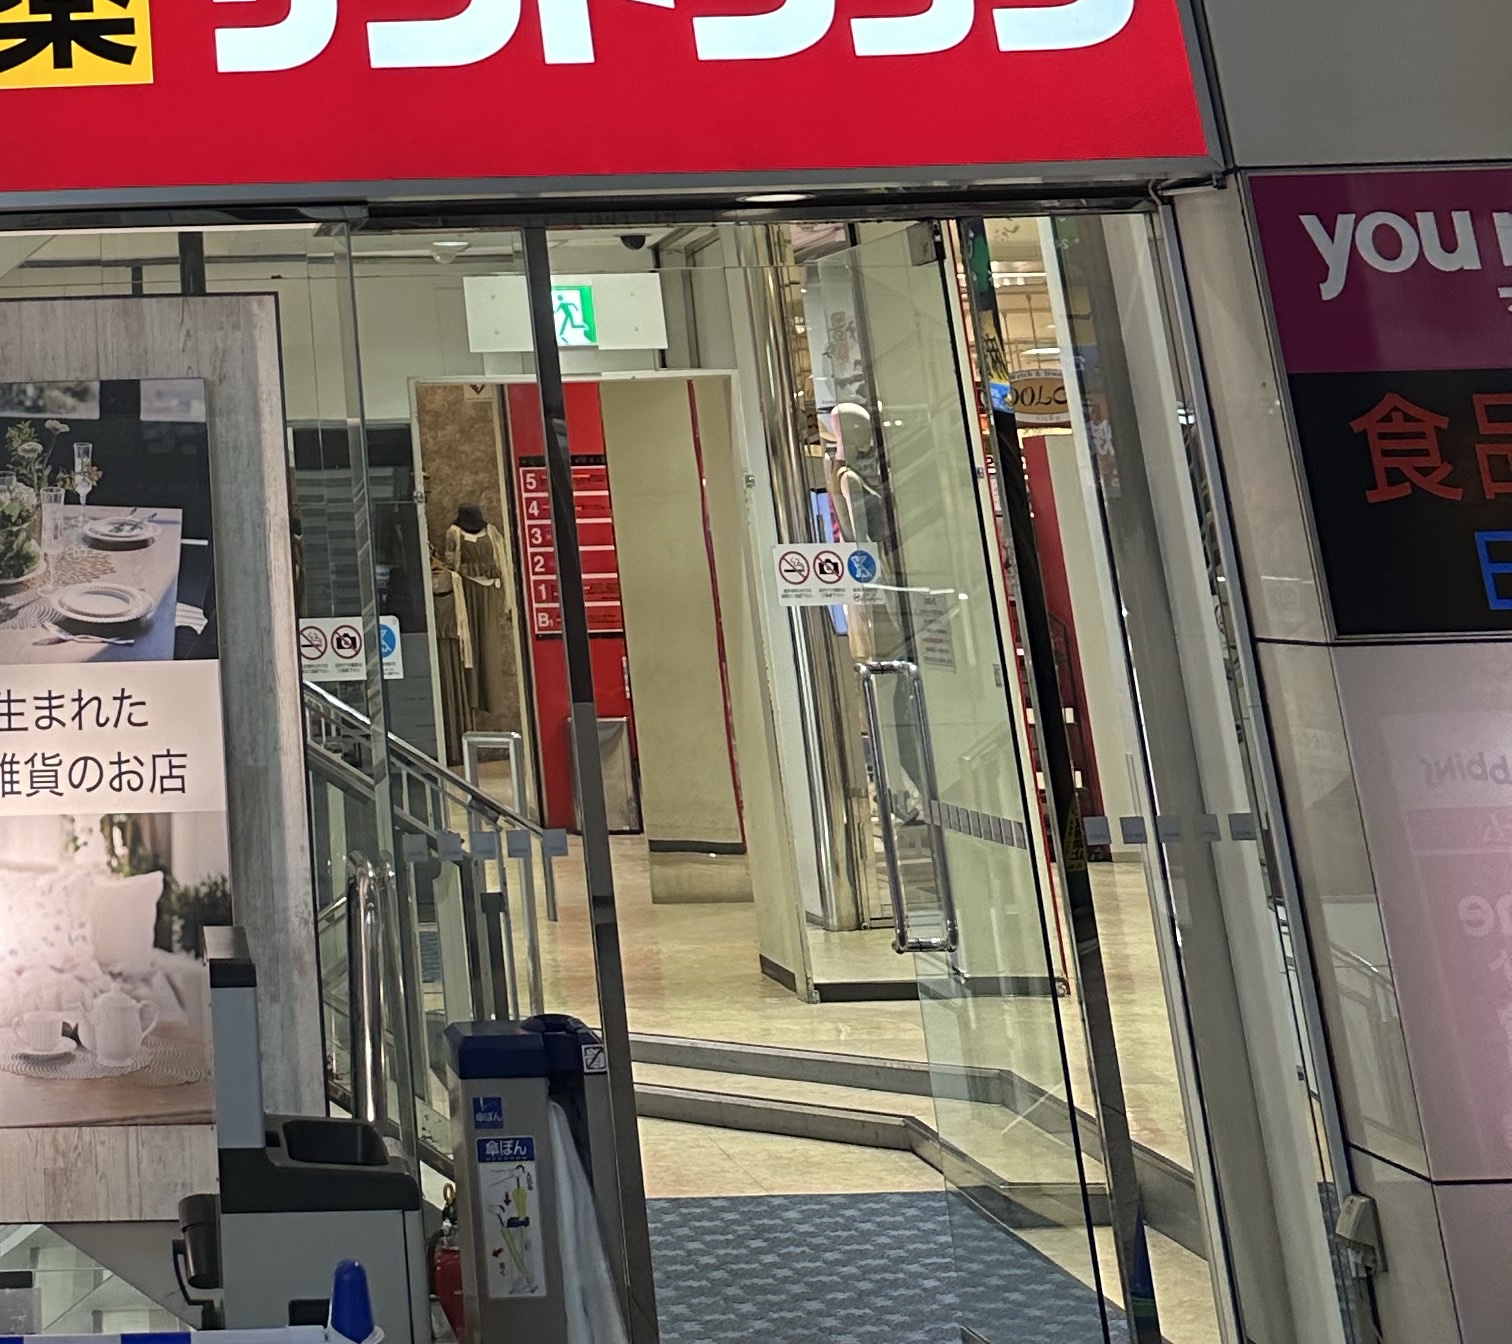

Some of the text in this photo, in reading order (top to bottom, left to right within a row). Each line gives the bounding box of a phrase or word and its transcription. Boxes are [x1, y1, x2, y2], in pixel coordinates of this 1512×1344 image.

[526, 473, 537, 490] 5
[528, 500, 540, 517] 4
[530, 528, 543, 545] 3
[533, 555, 545, 573] 2
[538, 583, 547, 601] 1
